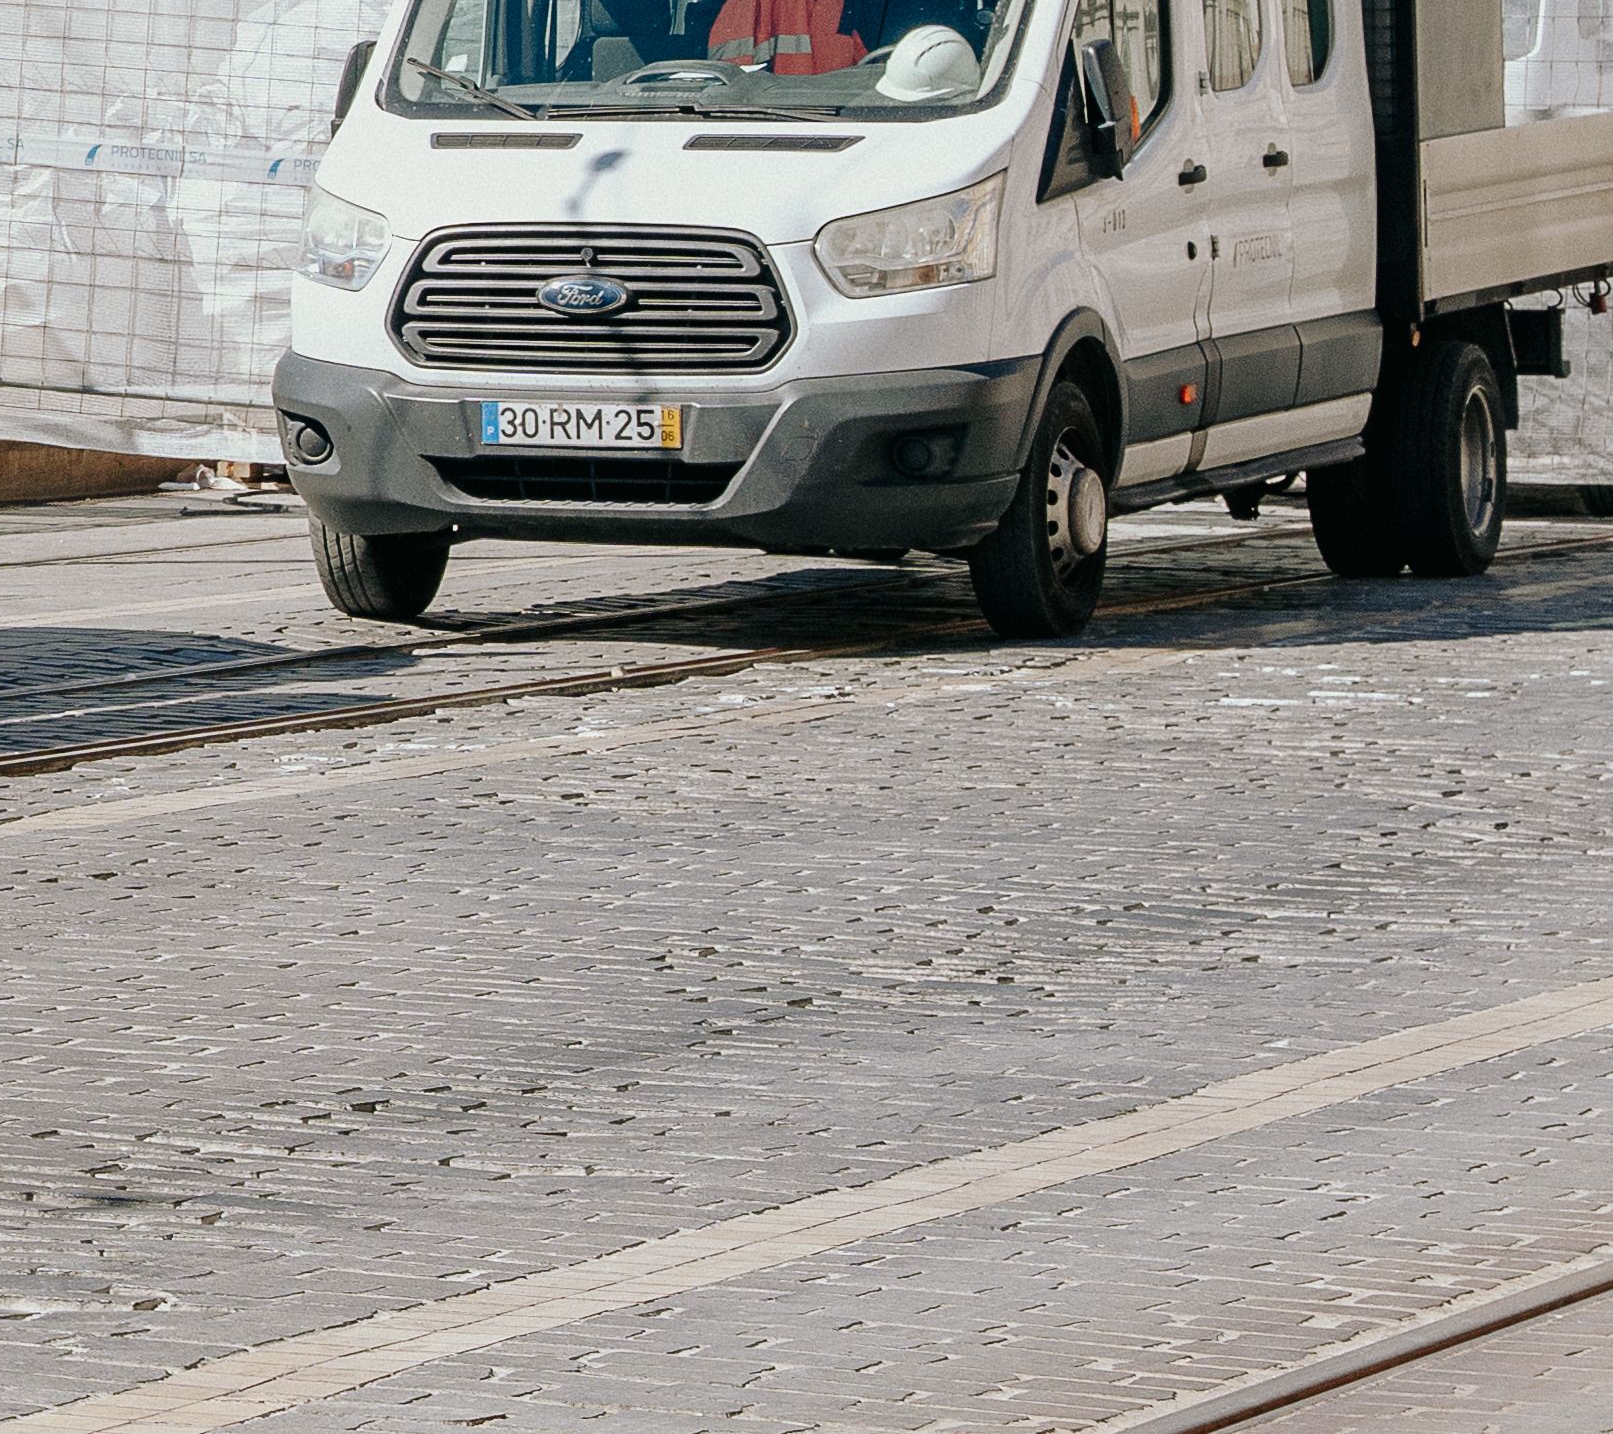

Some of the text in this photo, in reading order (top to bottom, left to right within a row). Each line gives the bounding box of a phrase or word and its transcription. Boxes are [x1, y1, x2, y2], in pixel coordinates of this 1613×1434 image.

[7, 136, 25, 150] SA
[111, 145, 207, 164] PROTECNIL SA
[558, 283, 605, 306] Ford
[661, 429, 675, 441] 06
